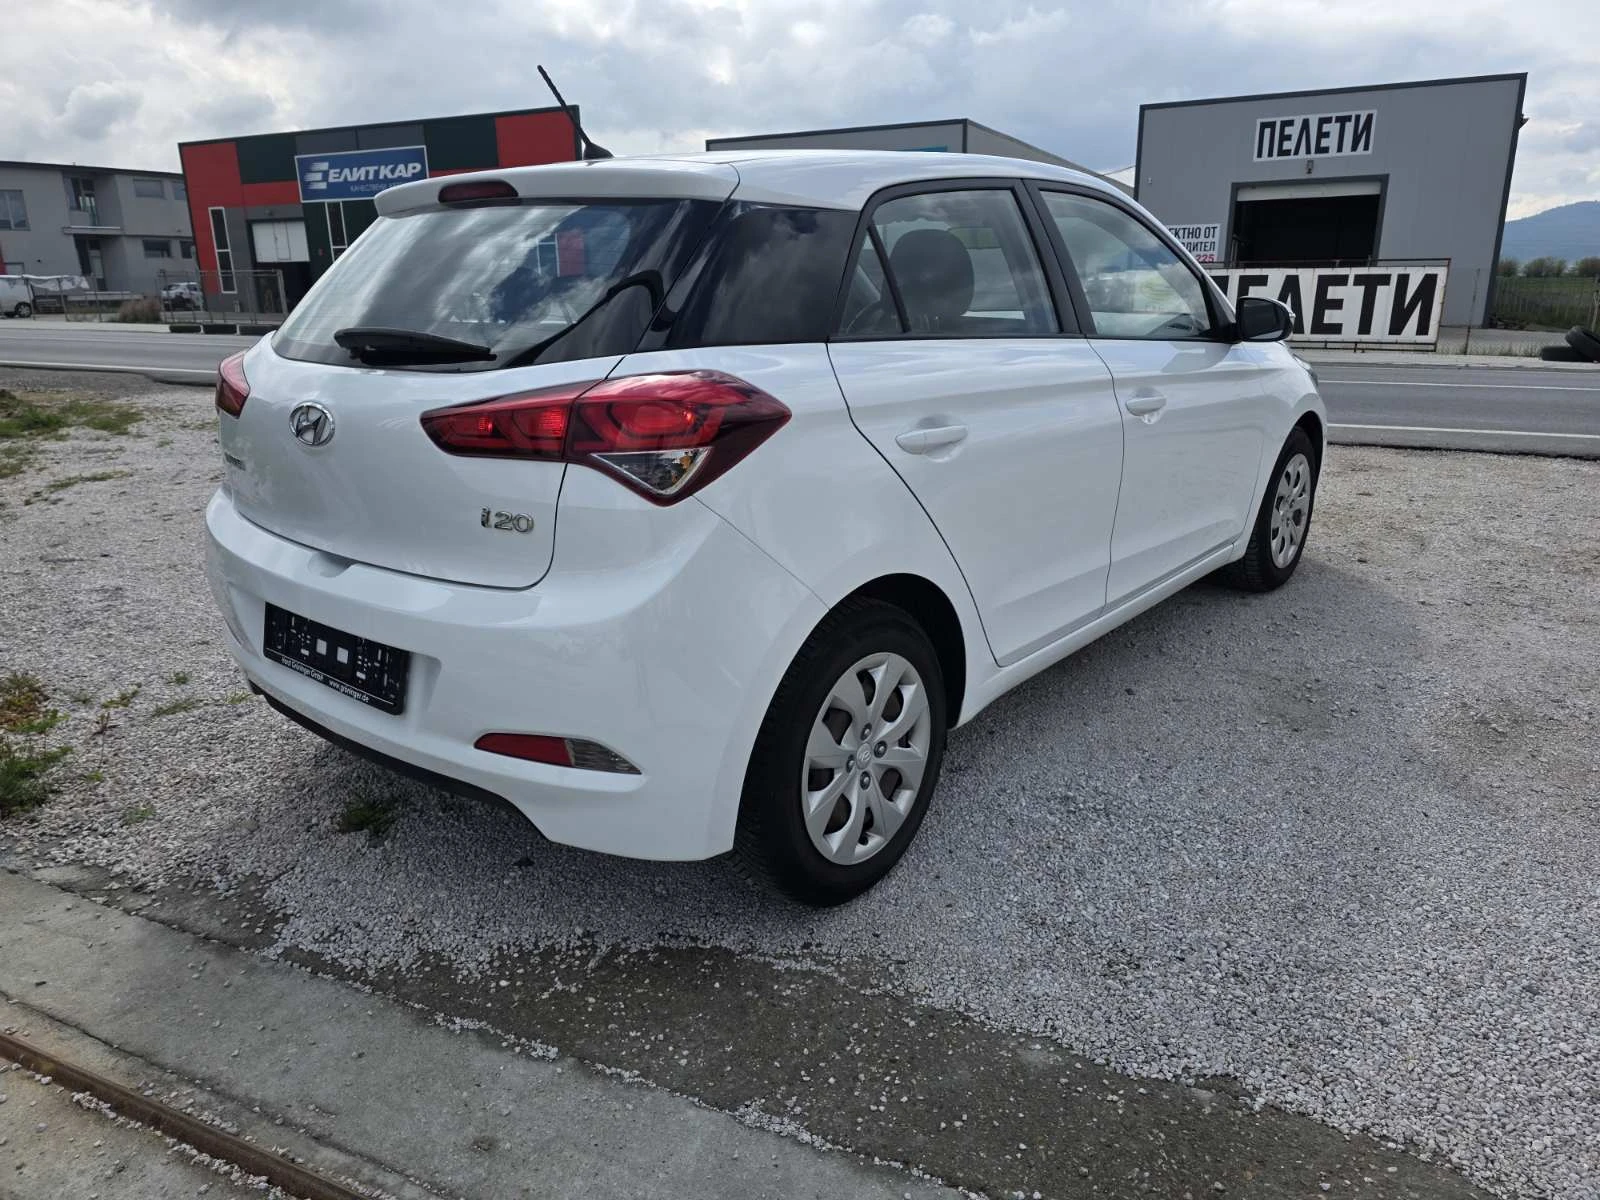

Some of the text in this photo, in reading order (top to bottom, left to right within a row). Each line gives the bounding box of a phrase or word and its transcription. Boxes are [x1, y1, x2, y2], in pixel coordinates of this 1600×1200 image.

[1256, 112, 1374, 159] ПЕЛЕТИ
[1204, 226, 1218, 239] ОТ
[1182, 241, 1216, 253] ДИТЕЛ
[481, 507, 534, 533] i20
